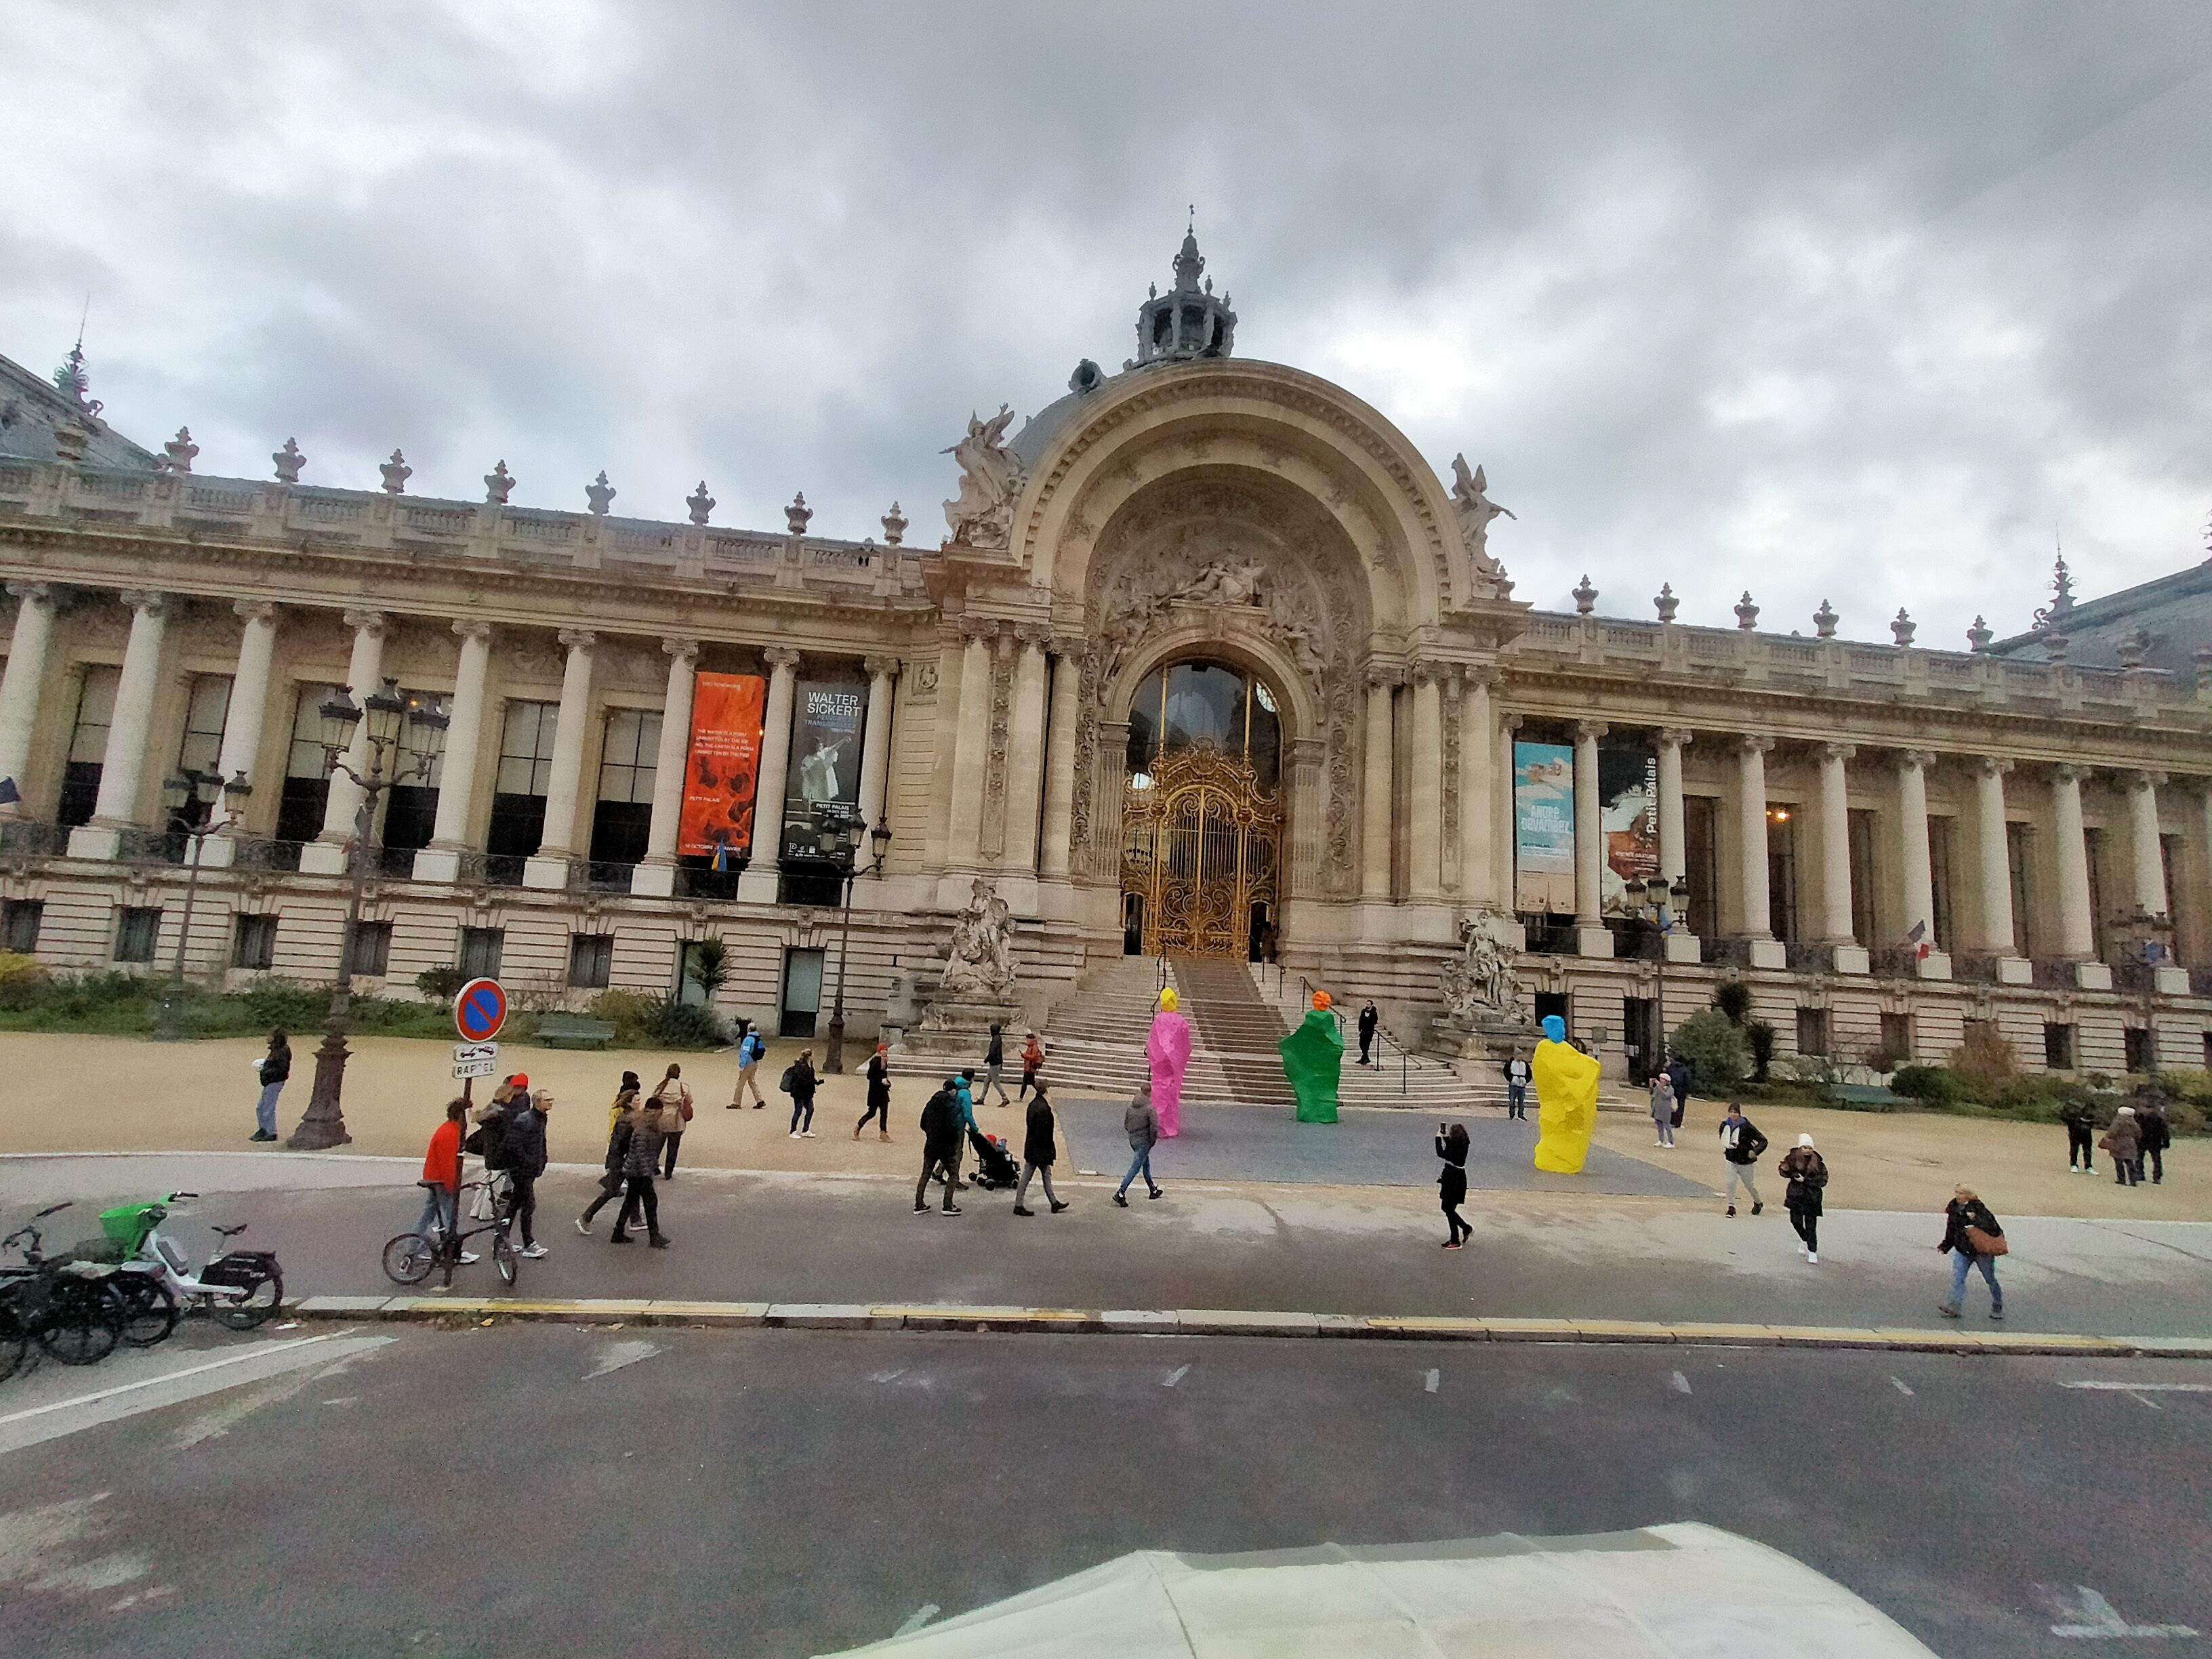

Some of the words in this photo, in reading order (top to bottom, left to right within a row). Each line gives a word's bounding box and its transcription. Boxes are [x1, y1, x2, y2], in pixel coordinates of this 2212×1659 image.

[808, 691, 859, 705] WALTER
[807, 703, 861, 717] SICKERT
[1645, 757, 1656, 798] Palais
[457, 1062, 494, 1075] RAPEL
